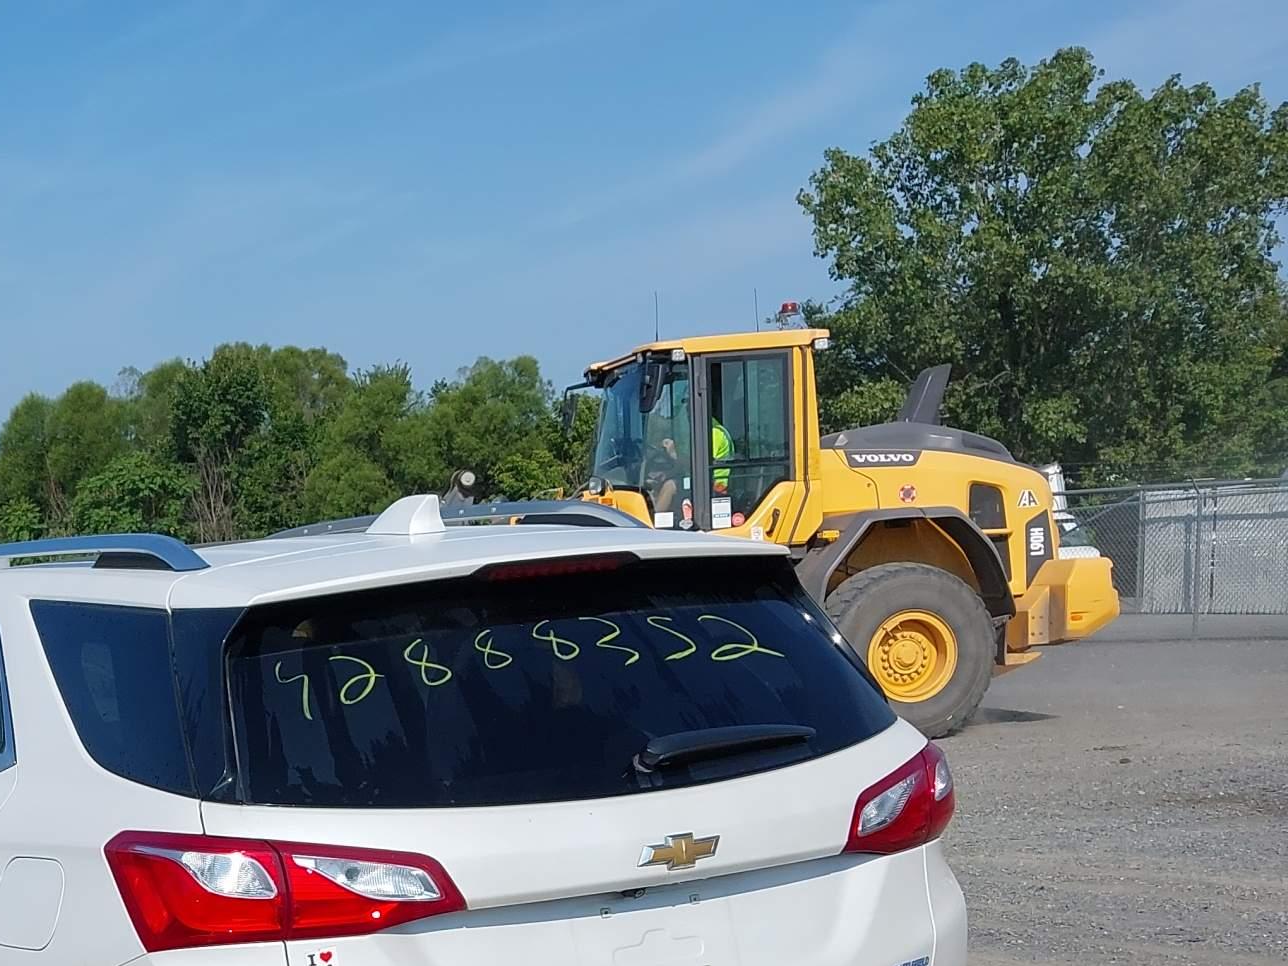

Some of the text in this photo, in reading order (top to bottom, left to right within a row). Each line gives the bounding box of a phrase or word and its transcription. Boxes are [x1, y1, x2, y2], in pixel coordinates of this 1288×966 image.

[851, 453, 915, 463] VOLVO
[1029, 527, 1045, 556] L90H
[275, 615, 785, 720] 42888352
[307, 953, 317, 966] I
